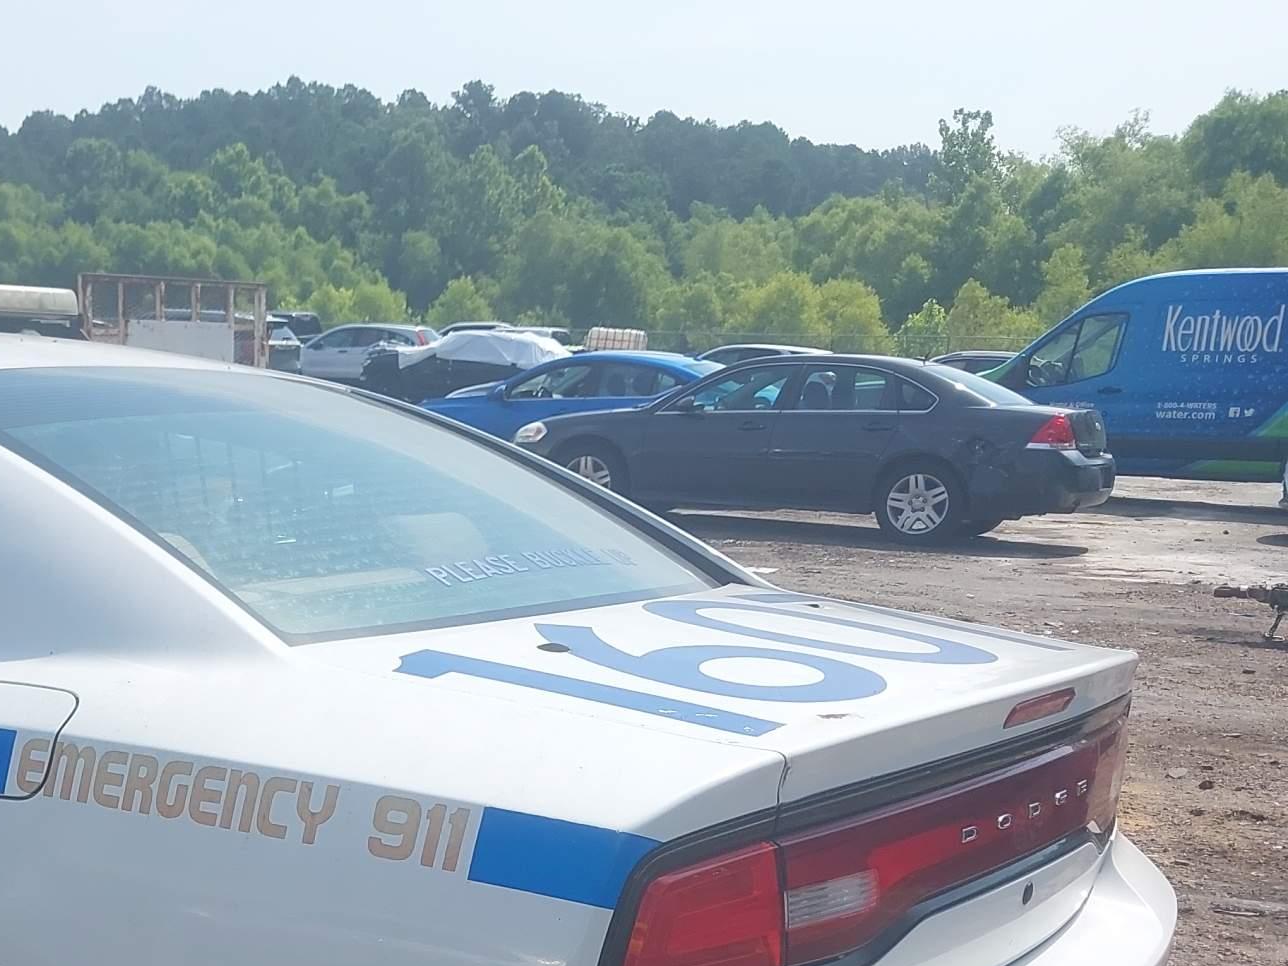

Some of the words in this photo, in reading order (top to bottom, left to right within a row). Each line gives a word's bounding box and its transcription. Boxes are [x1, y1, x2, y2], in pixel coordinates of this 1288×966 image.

[1162, 304, 1286, 352] Kentwood
[1180, 354, 1257, 363] SPRINGS
[1155, 410, 1216, 420] water.com
[425, 554, 529, 587] PLEASE
[520, 548, 607, 570] BUCKLE
[16, 736, 341, 846] EMERGENCY
[367, 794, 472, 873] 911
[962, 779, 1088, 844] DODGE
